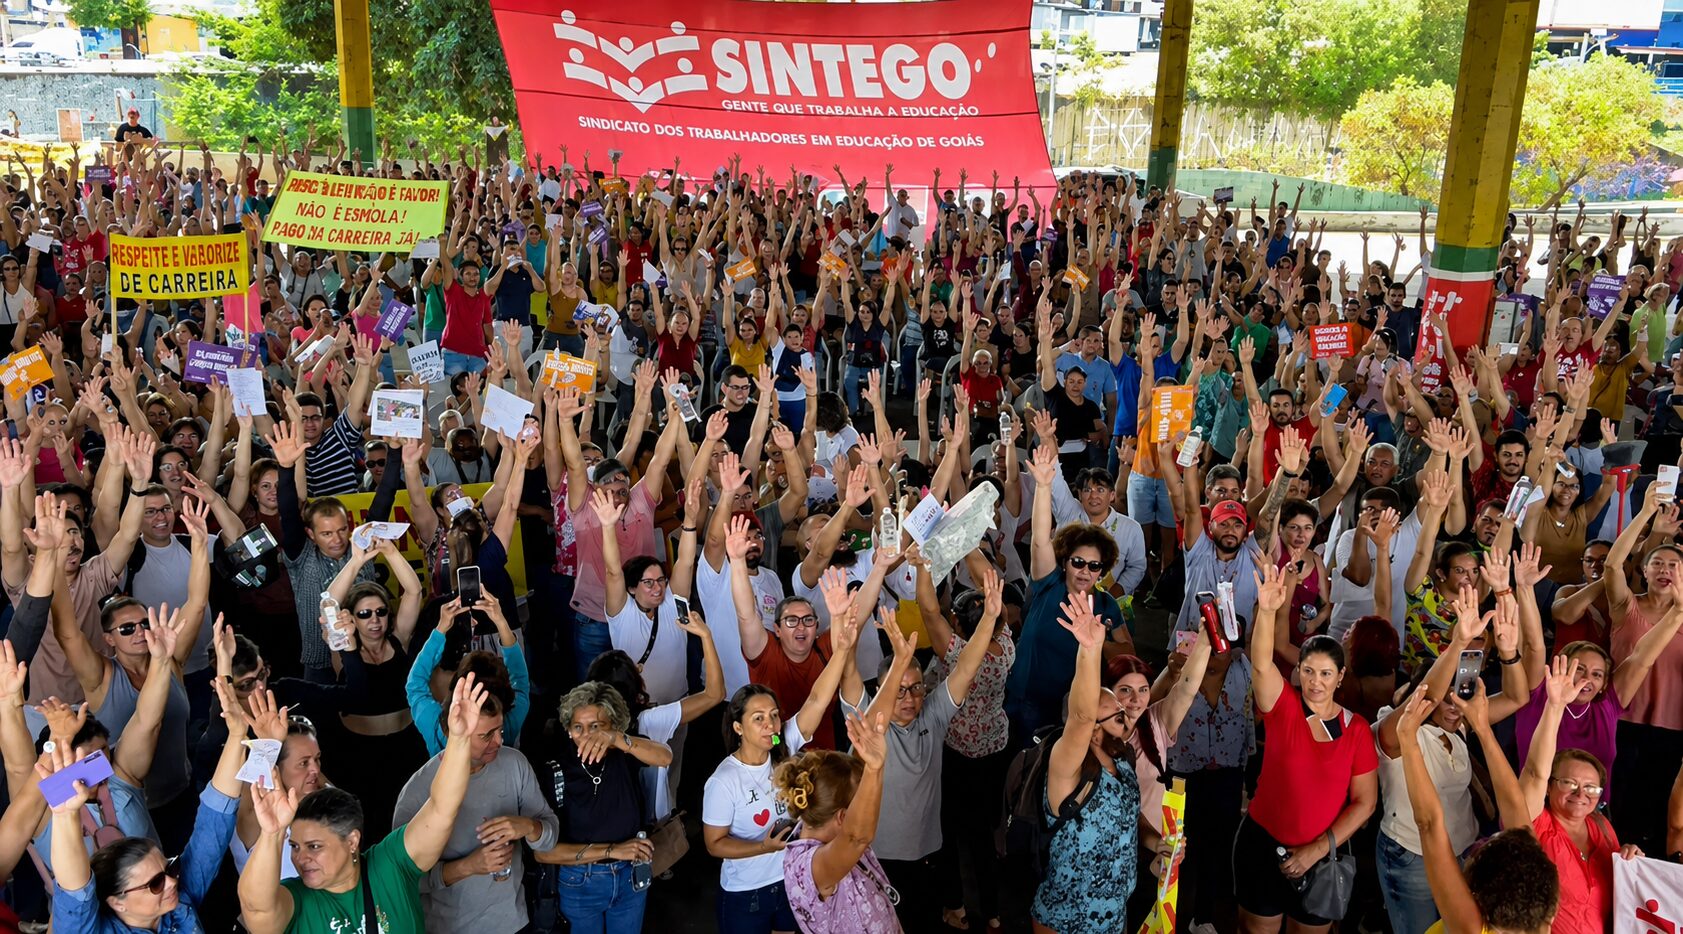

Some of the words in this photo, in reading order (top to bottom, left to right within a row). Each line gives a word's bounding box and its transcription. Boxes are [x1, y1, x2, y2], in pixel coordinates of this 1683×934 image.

[711, 38, 972, 100] SINTEGO
[721, 100, 769, 113] GENTE
[773, 103, 803, 115] QUE
[806, 104, 884, 116] TRABALHA
[888, 106, 898, 117] A
[901, 103, 979, 120] EDUCAÇÃO
[578, 116, 651, 134] SINDICATO
[654, 123, 684, 137] DOS
[687, 126, 807, 145] TRABALHADORES
[811, 134, 832, 146] EM
[836, 134, 913, 150] EDUCAÇÃO
[917, 137, 936, 147] DE
[939, 133, 985, 147] GOIÁS
[399, 187, 441, 203] FAVOR!
[295, 201, 326, 219] NÃO
[271, 221, 305, 239] PAGO
[307, 224, 324, 241] NA
[327, 228, 391, 245] CARREIRA
[112, 243, 169, 268] RESPEITE
[172, 245, 180, 267] E
[120, 272, 143, 294] DE
[148, 269, 238, 294] CARREIRA
